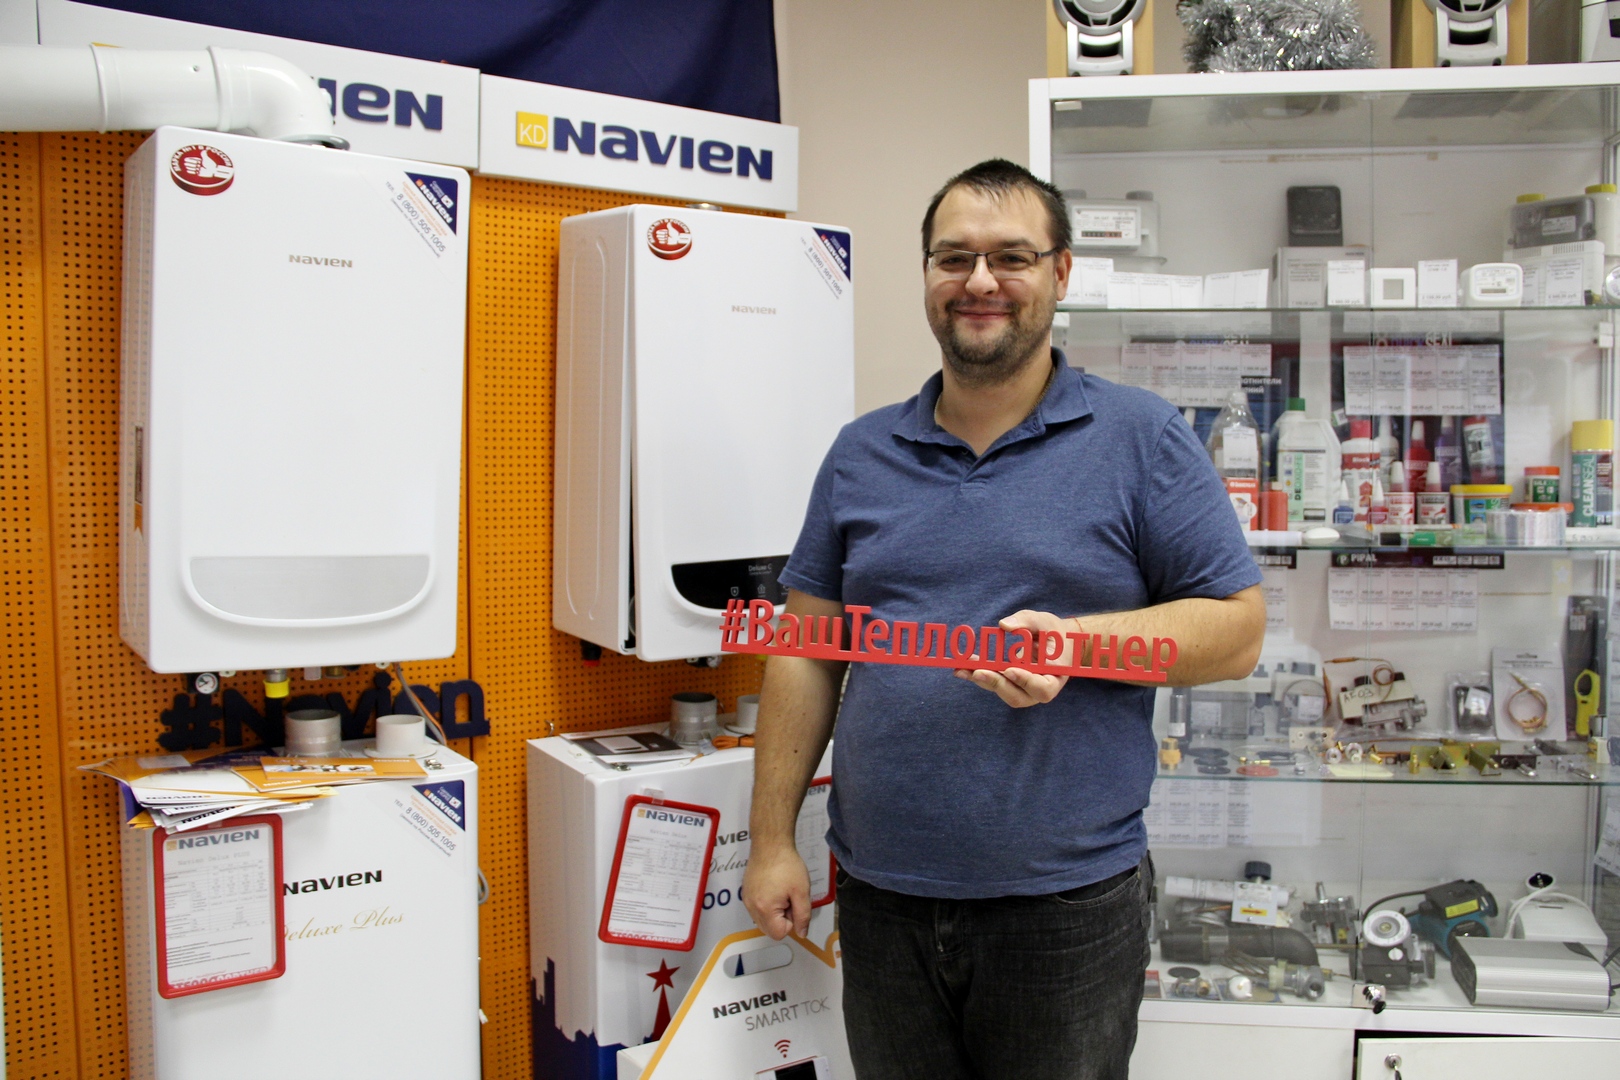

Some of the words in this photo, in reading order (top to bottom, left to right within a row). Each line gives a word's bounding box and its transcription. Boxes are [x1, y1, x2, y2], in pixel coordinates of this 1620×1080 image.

[519, 123, 546, 144] KD
[401, 200, 420, 220] (800)
[417, 219, 431, 234] 505
[429, 234, 446, 252] 1005
[411, 812, 429, 828] (800)
[427, 825, 440, 837] 505
[440, 836, 456, 851] 1005
[349, 905, 404, 930] Plus
[745, 1004, 799, 1031] SMART
[800, 996, 831, 1015] TOK
